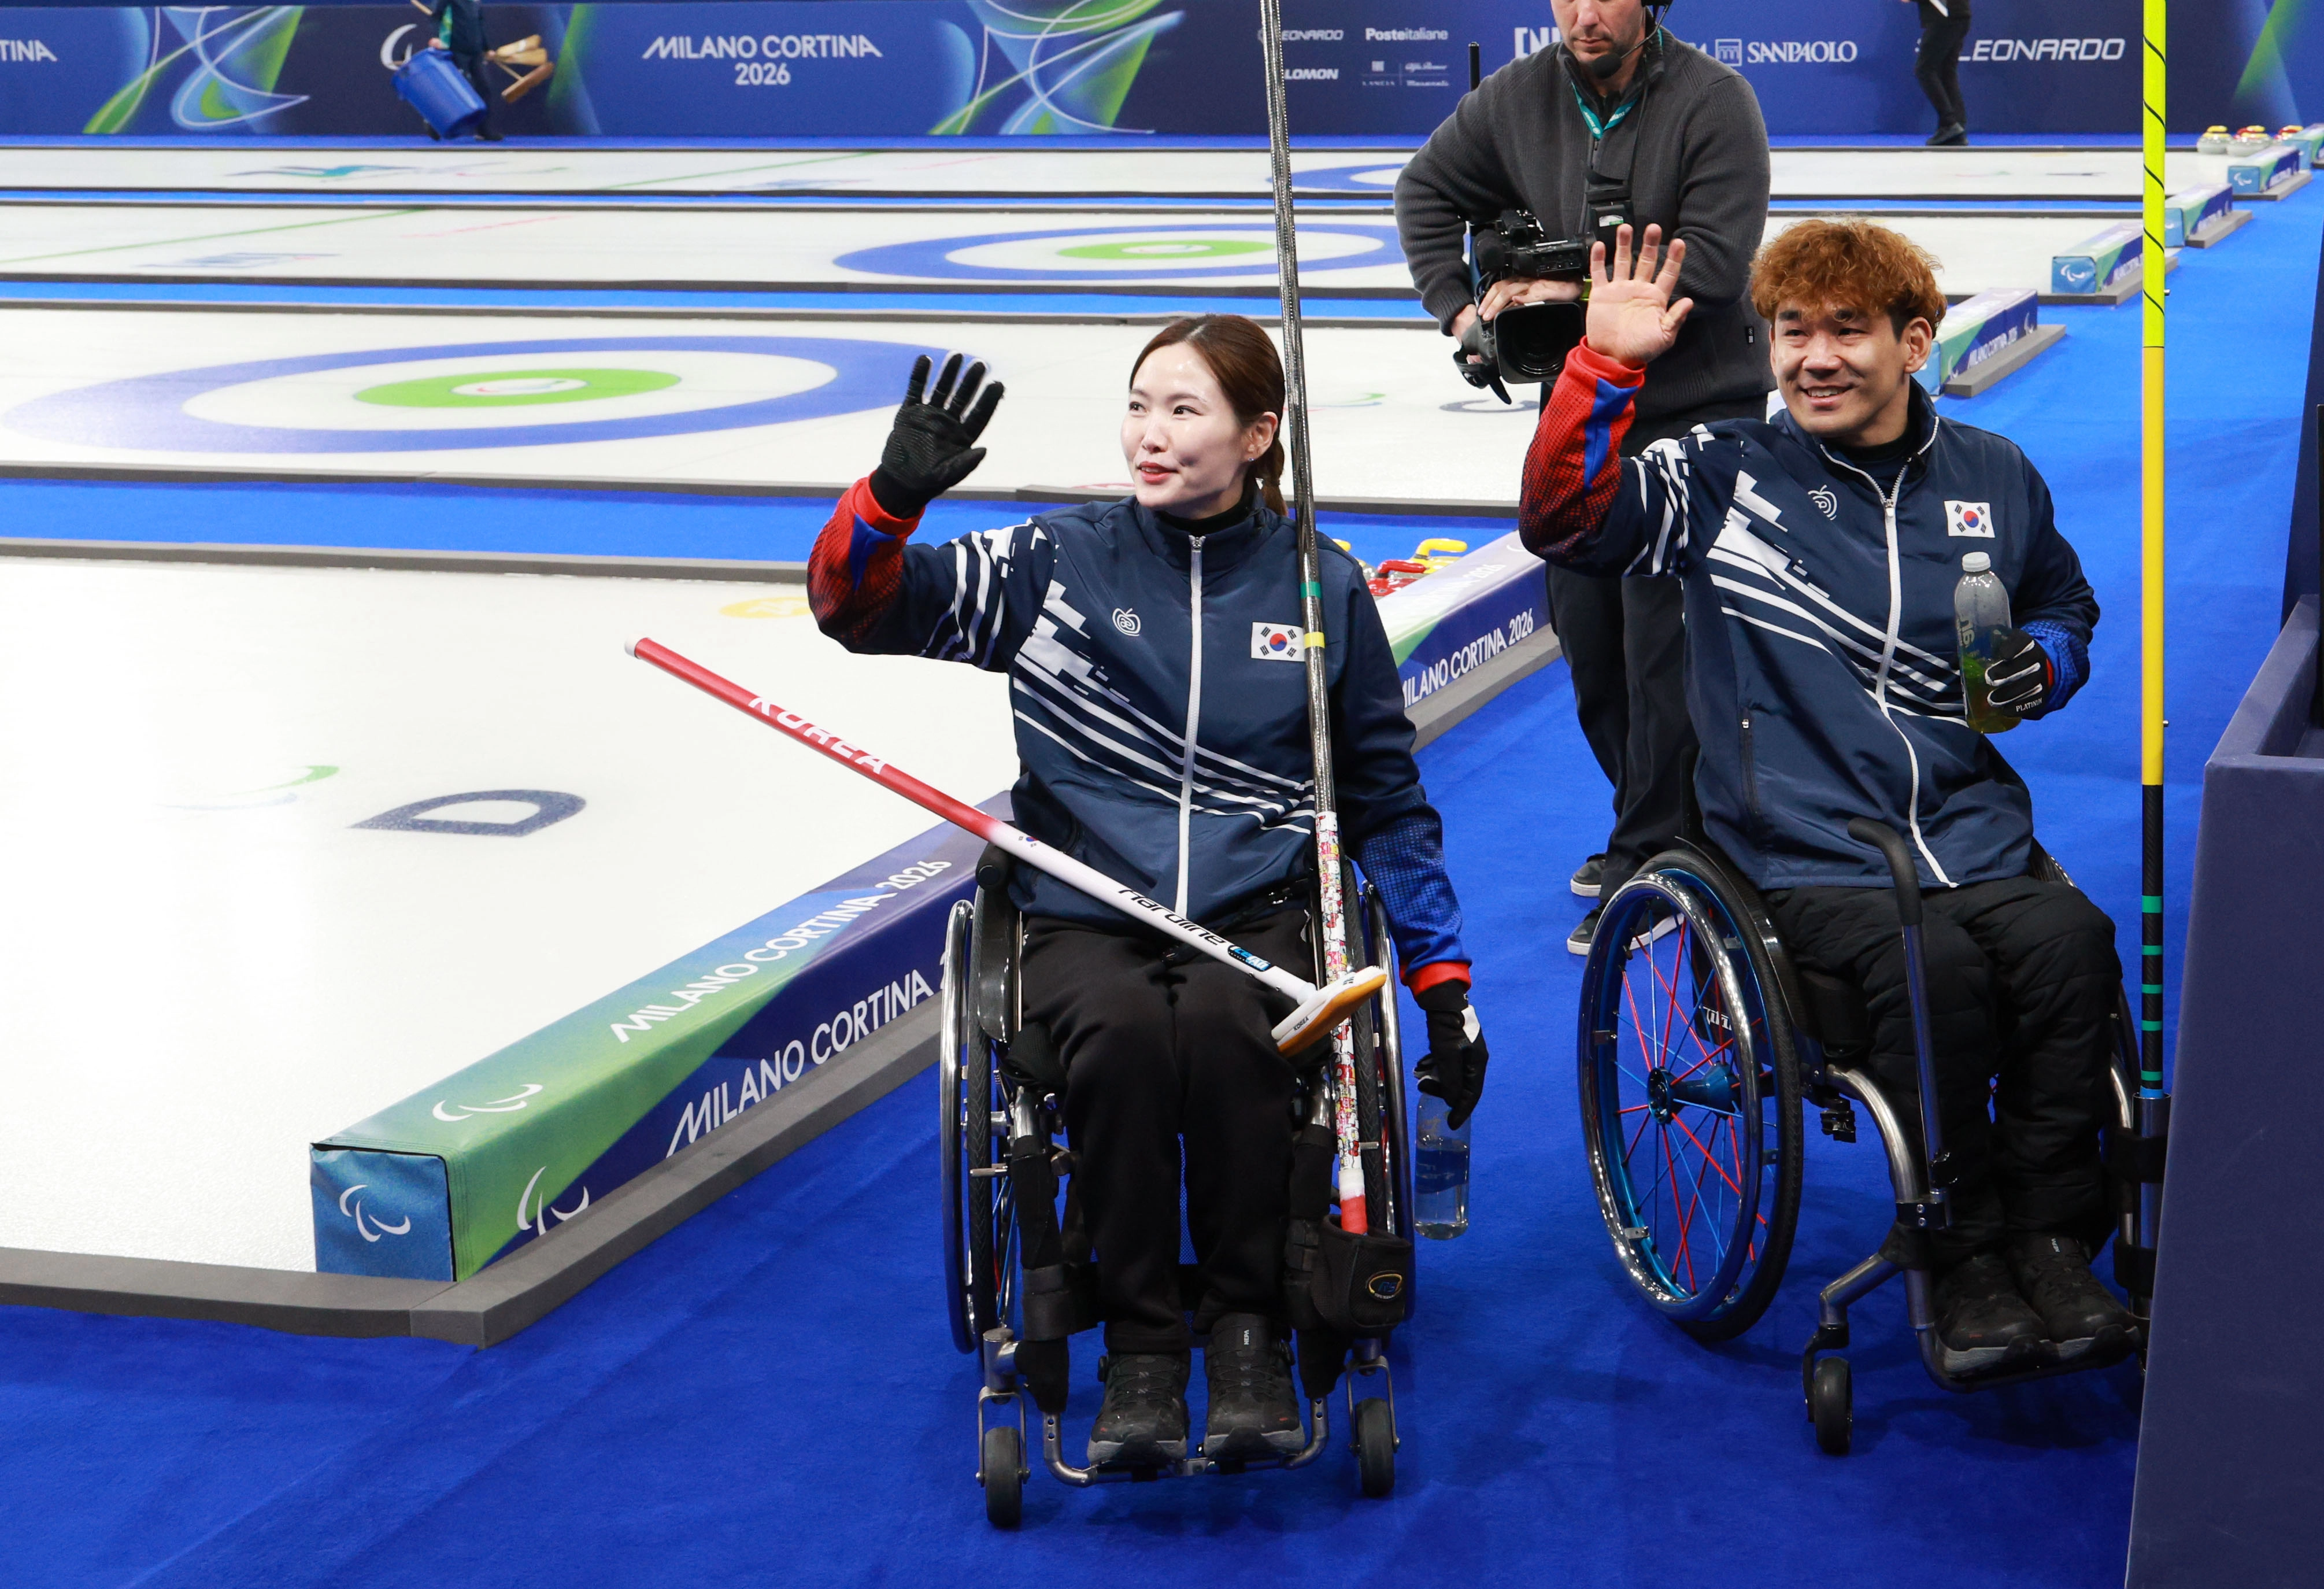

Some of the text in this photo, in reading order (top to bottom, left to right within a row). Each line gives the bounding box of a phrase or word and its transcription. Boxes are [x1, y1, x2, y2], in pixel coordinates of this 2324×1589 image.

[643, 34, 883, 59] MILANO CORTINA
[1282, 29, 1344, 41] EONARDO
[1747, 40, 1857, 63] SANPAOLO
[735, 63, 791, 86] 2026
[1284, 68, 1339, 80] LOMON
[1450, 627, 1507, 679] CORTINA
[1508, 608, 1534, 645] 2026
[346, 789, 587, 837] D
[610, 859, 952, 1044] MILANO CORTINA 2026
[1293, 1016, 1309, 1032] KOREA
[666, 969, 934, 1158] MILANO CORTINA
